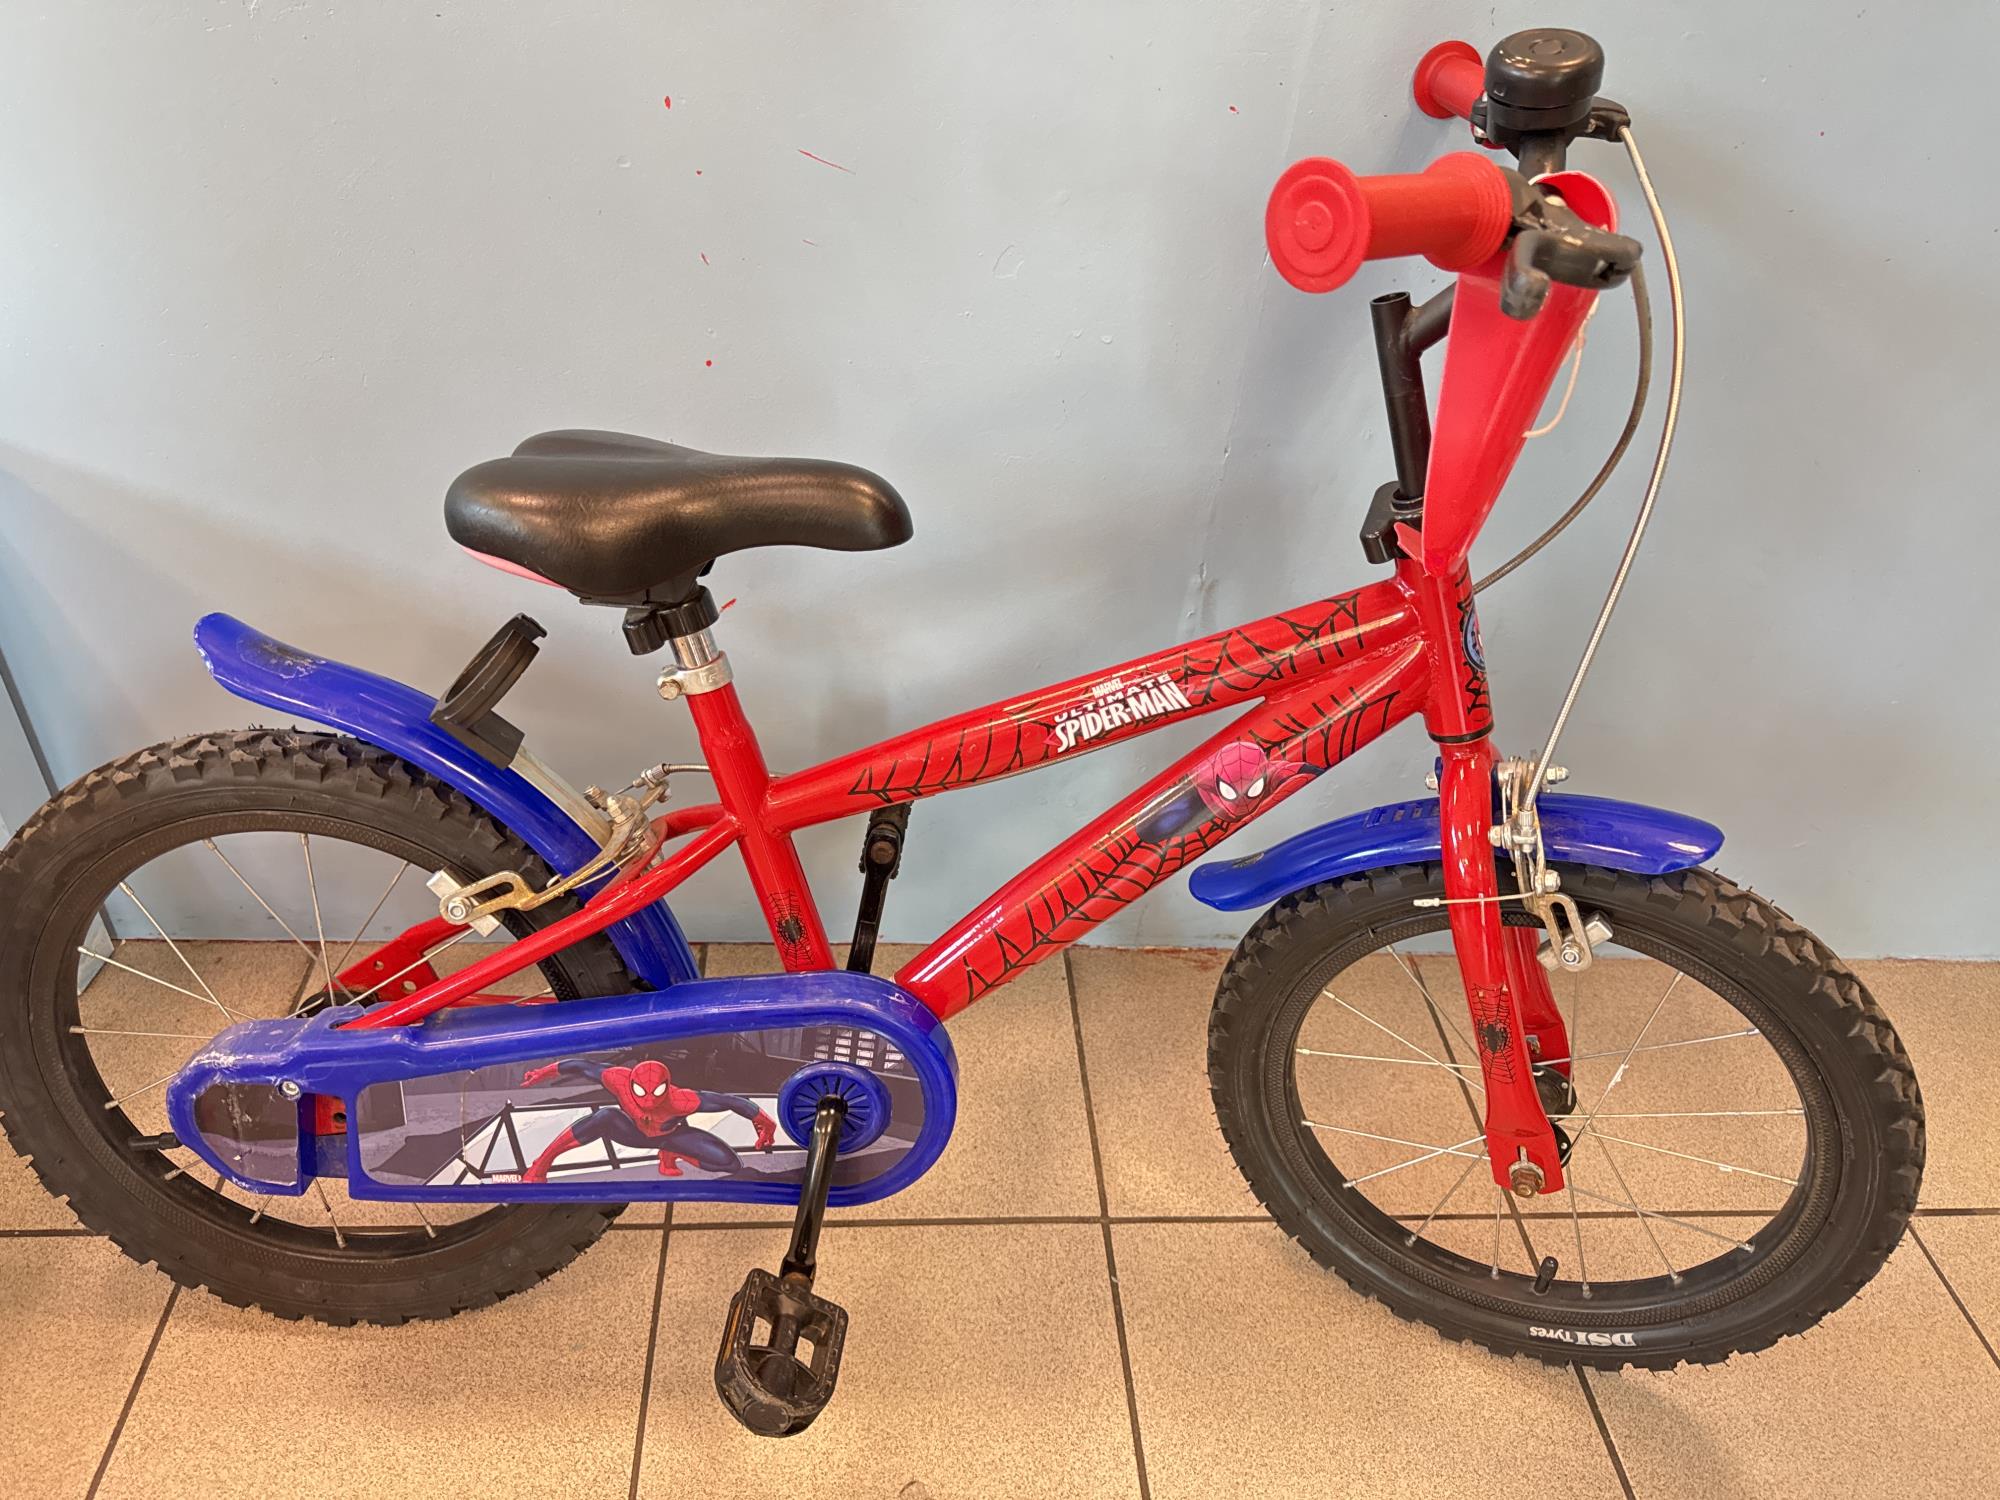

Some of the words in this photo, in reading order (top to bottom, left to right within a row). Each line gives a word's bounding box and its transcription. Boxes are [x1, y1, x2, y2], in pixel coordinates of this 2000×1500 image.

[1091, 678, 1125, 698] MARVEL
[1054, 674, 1172, 723] ULTIMATE
[1055, 681, 1192, 753] SPIDER-MAN
[491, 1174, 519, 1183] MARVEL
[1529, 1326, 1574, 1343] Tyres
[1575, 1331, 1637, 1347] DSI
